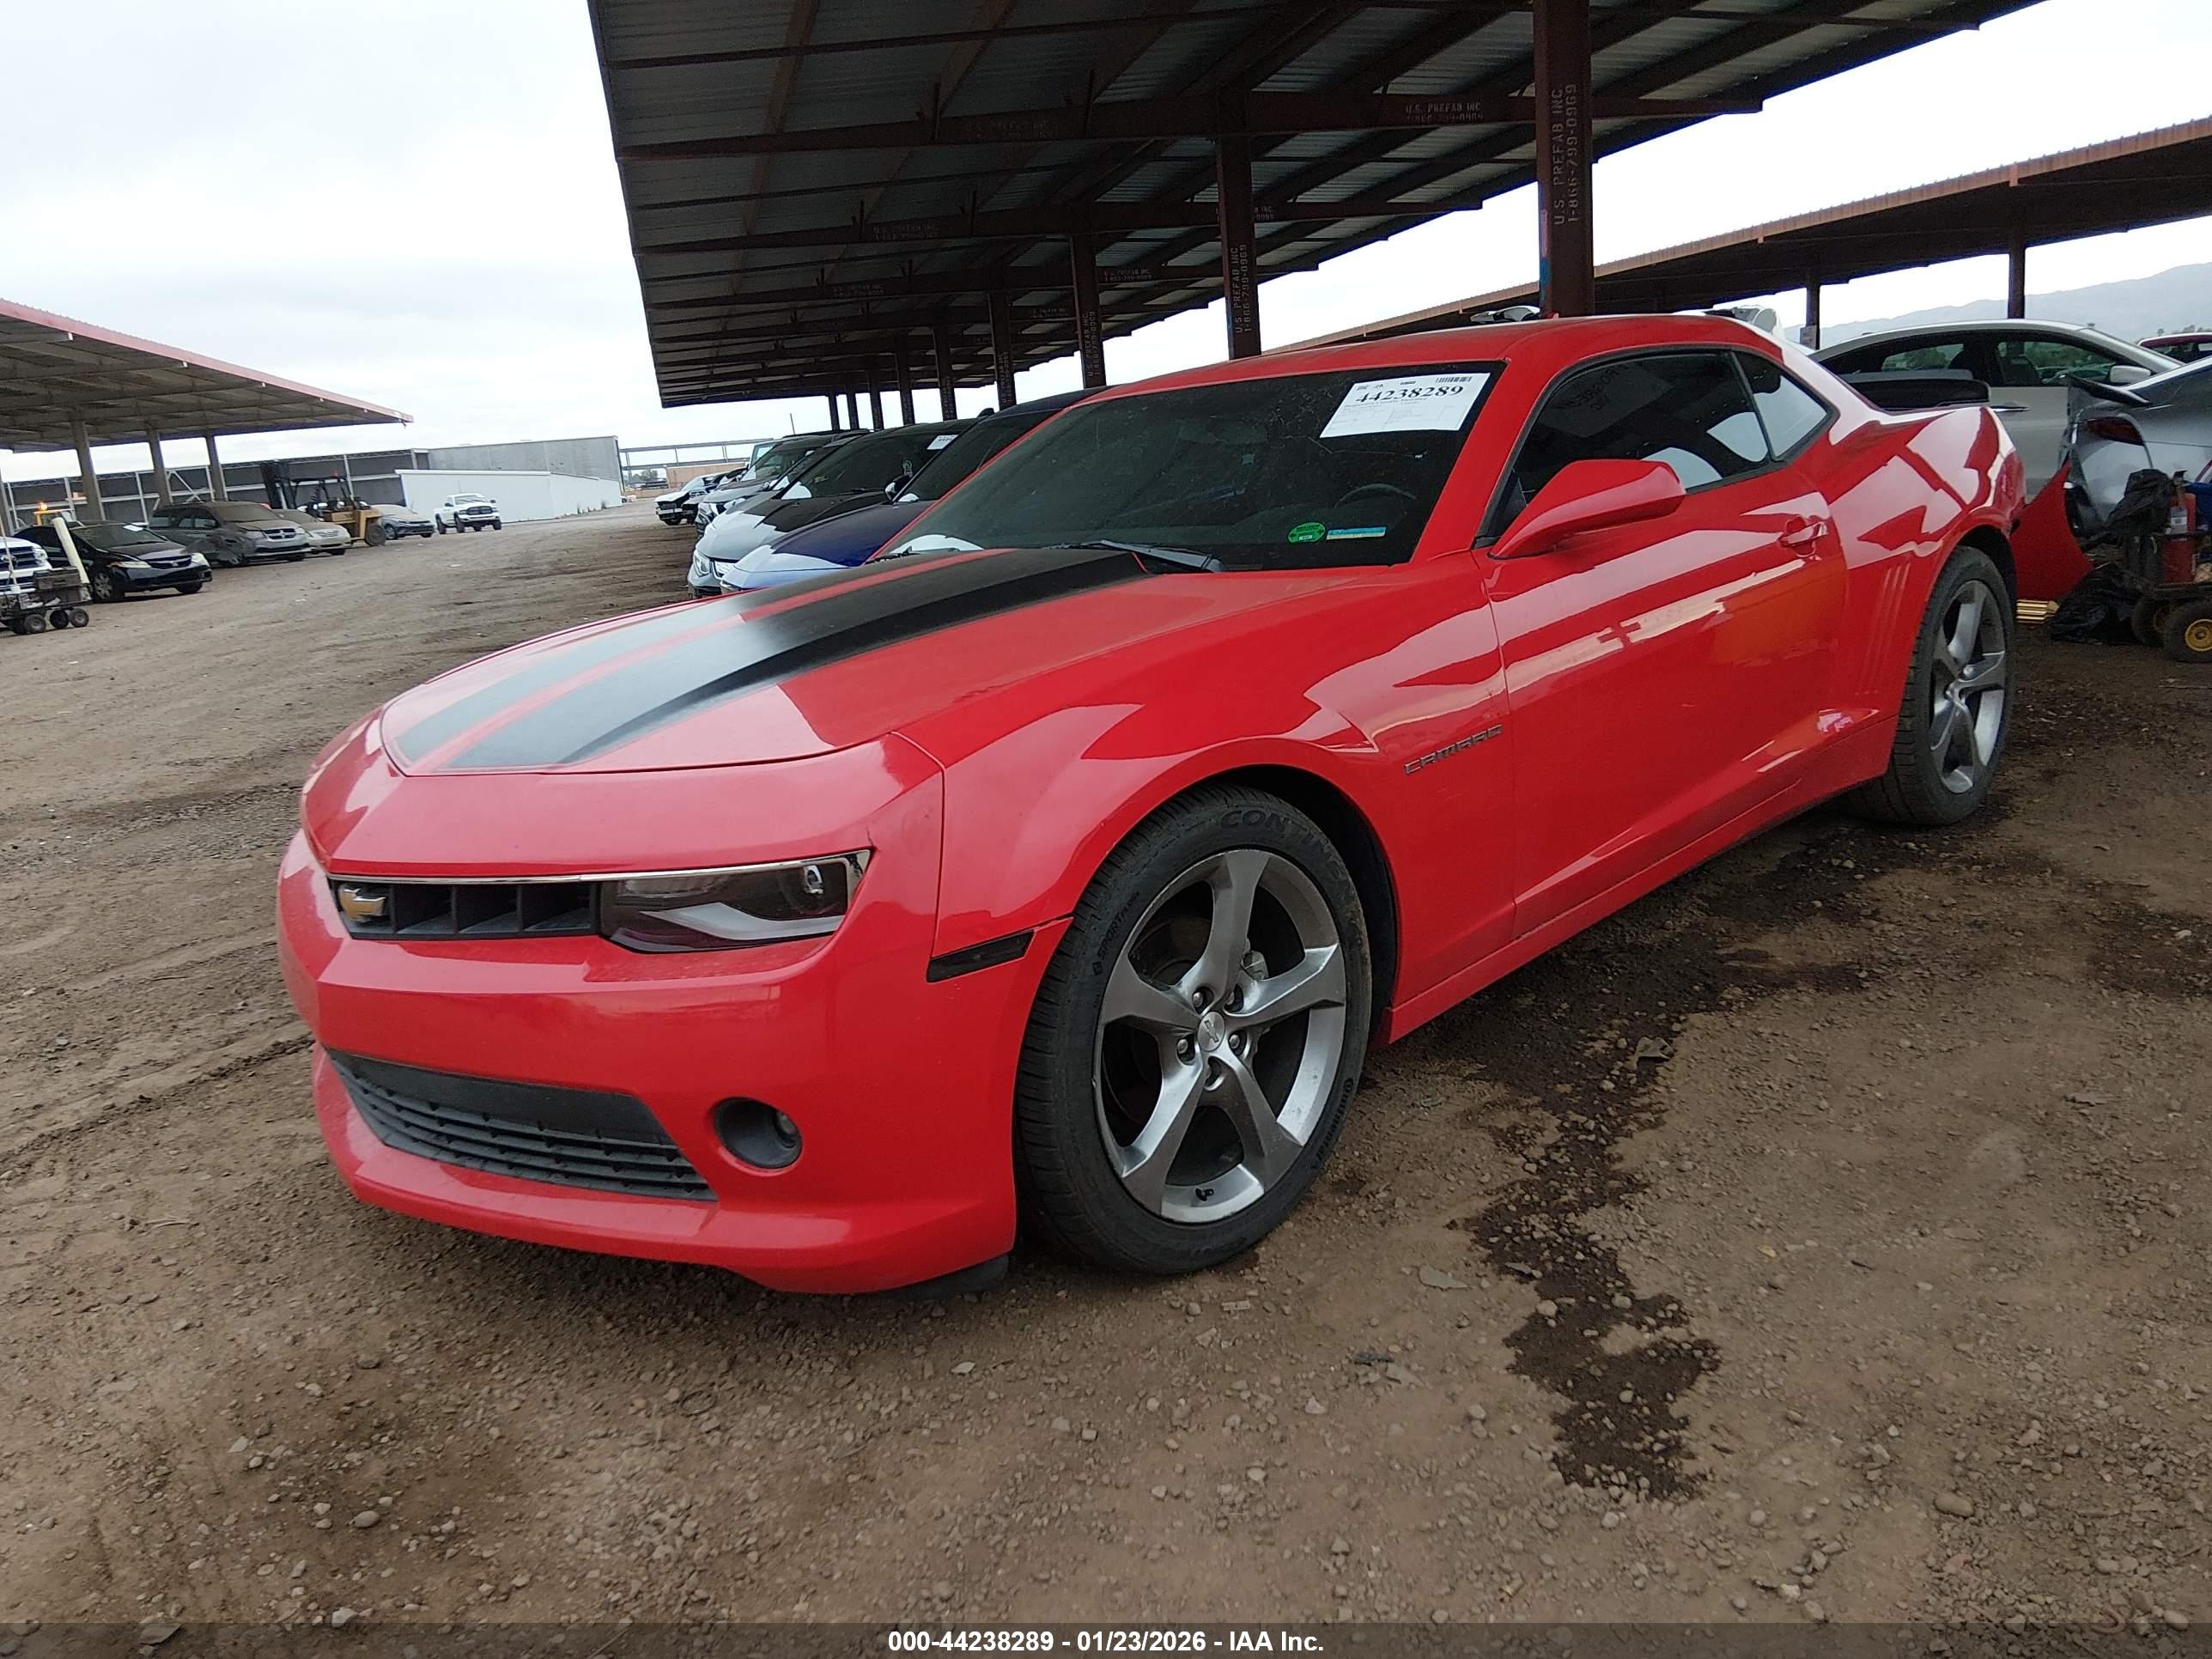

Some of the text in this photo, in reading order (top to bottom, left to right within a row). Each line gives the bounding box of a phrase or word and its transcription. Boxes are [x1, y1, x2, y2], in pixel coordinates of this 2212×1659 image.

[1552, 123, 1565, 185] PREFAB
[1565, 83, 1580, 222] 1-866-799-0969
[1553, 194, 1565, 225] U.S.
[1232, 269, 1242, 309] PREFAB
[1356, 386, 1463, 403] 44238289
[1404, 724, 1503, 775] CAMARO
